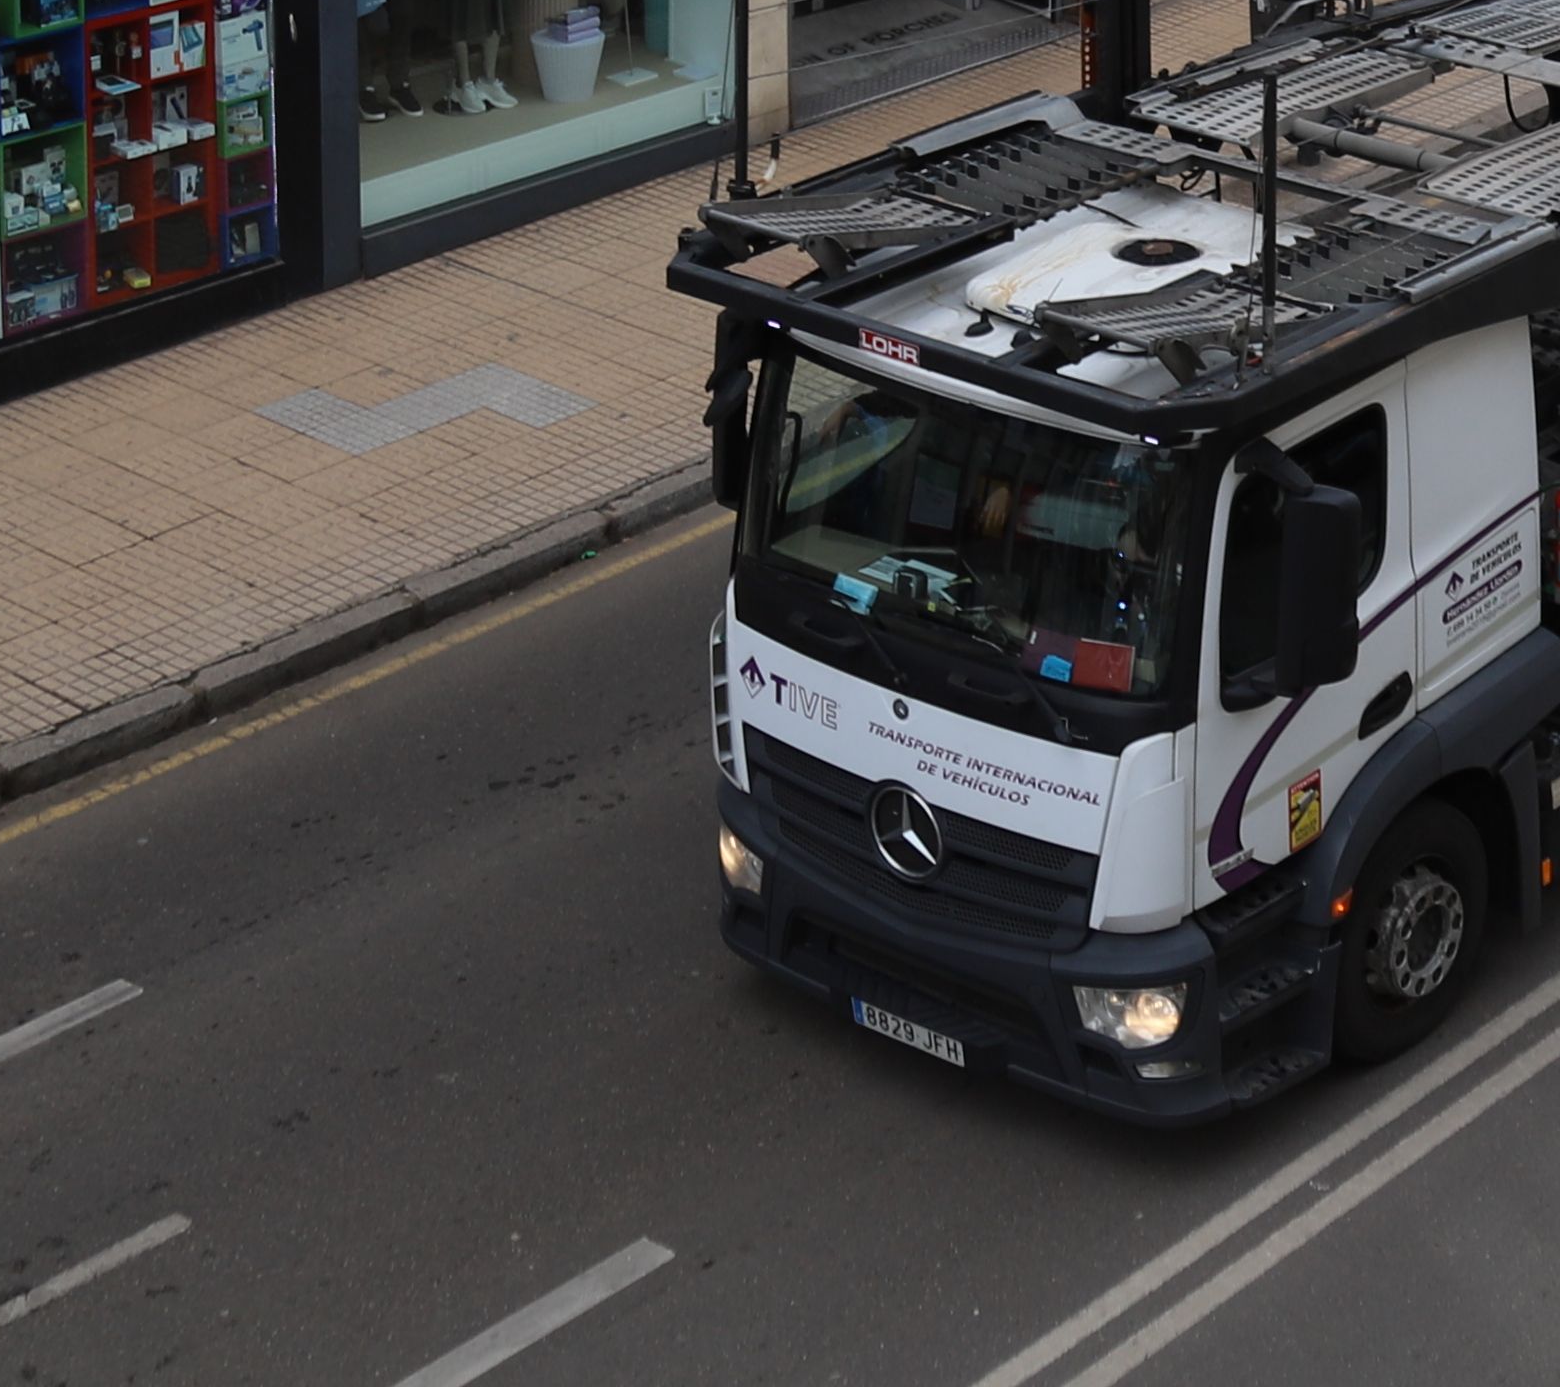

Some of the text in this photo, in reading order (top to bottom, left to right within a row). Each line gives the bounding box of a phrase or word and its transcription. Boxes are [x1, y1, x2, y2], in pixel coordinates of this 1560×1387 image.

[861, 331, 919, 364] LOHR
[770, 673, 838, 730] TIVE
[868, 721, 1101, 807] TRANSPORTE INTERNACIONAL
[916, 759, 1030, 808] DE VEHÍCULOS
[865, 1005, 960, 1063] 8829 JFH
